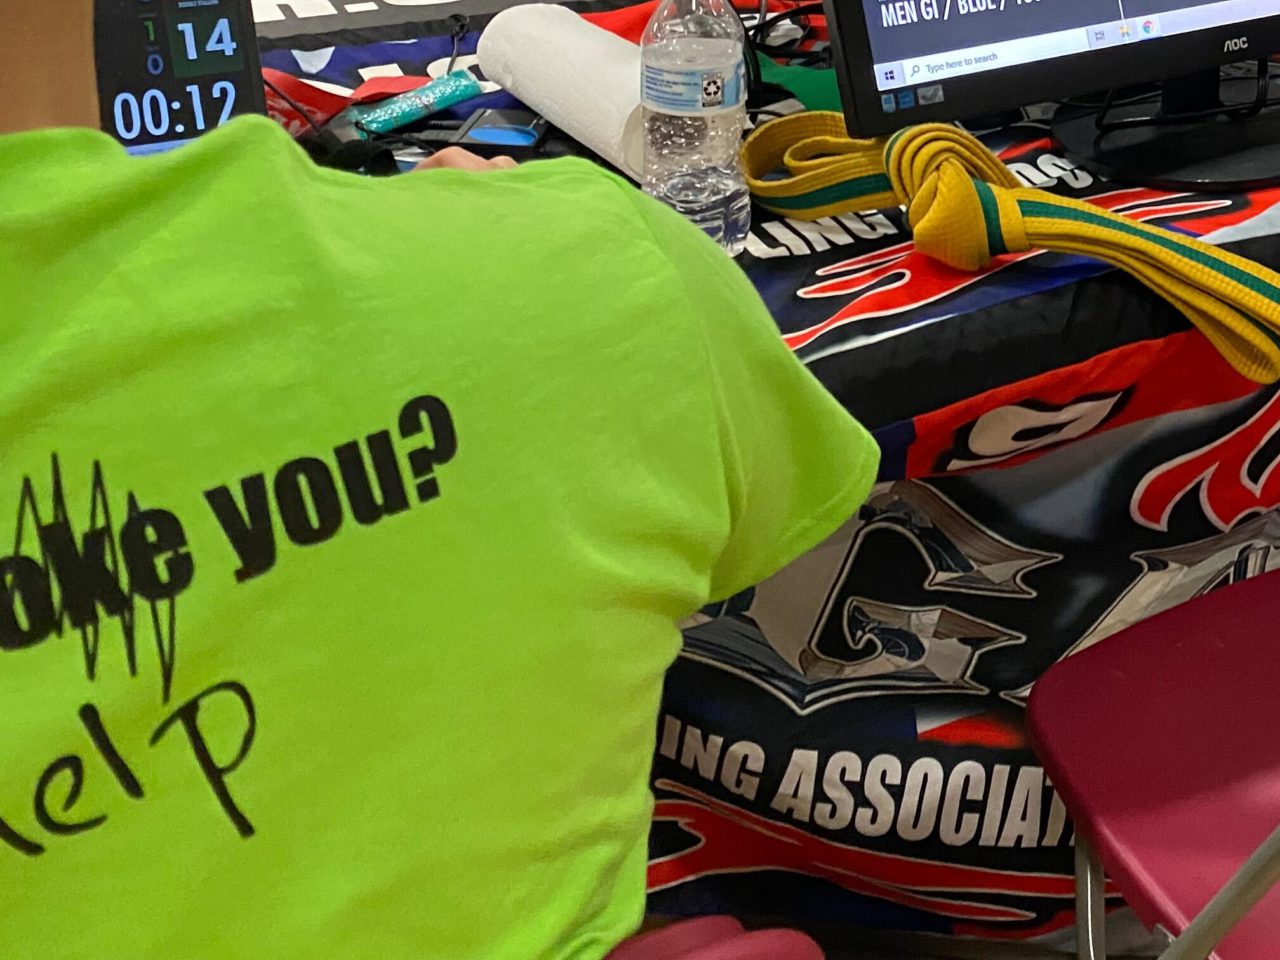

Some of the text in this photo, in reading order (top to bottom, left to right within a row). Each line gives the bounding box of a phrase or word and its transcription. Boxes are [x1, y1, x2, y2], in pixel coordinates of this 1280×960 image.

[881, 0, 918, 28] MEN
[177, 18, 237, 60] 14
[926, 52, 998, 74] Type here to search
[113, 80, 237, 140] 00:12
[205, 394, 458, 584] you?
